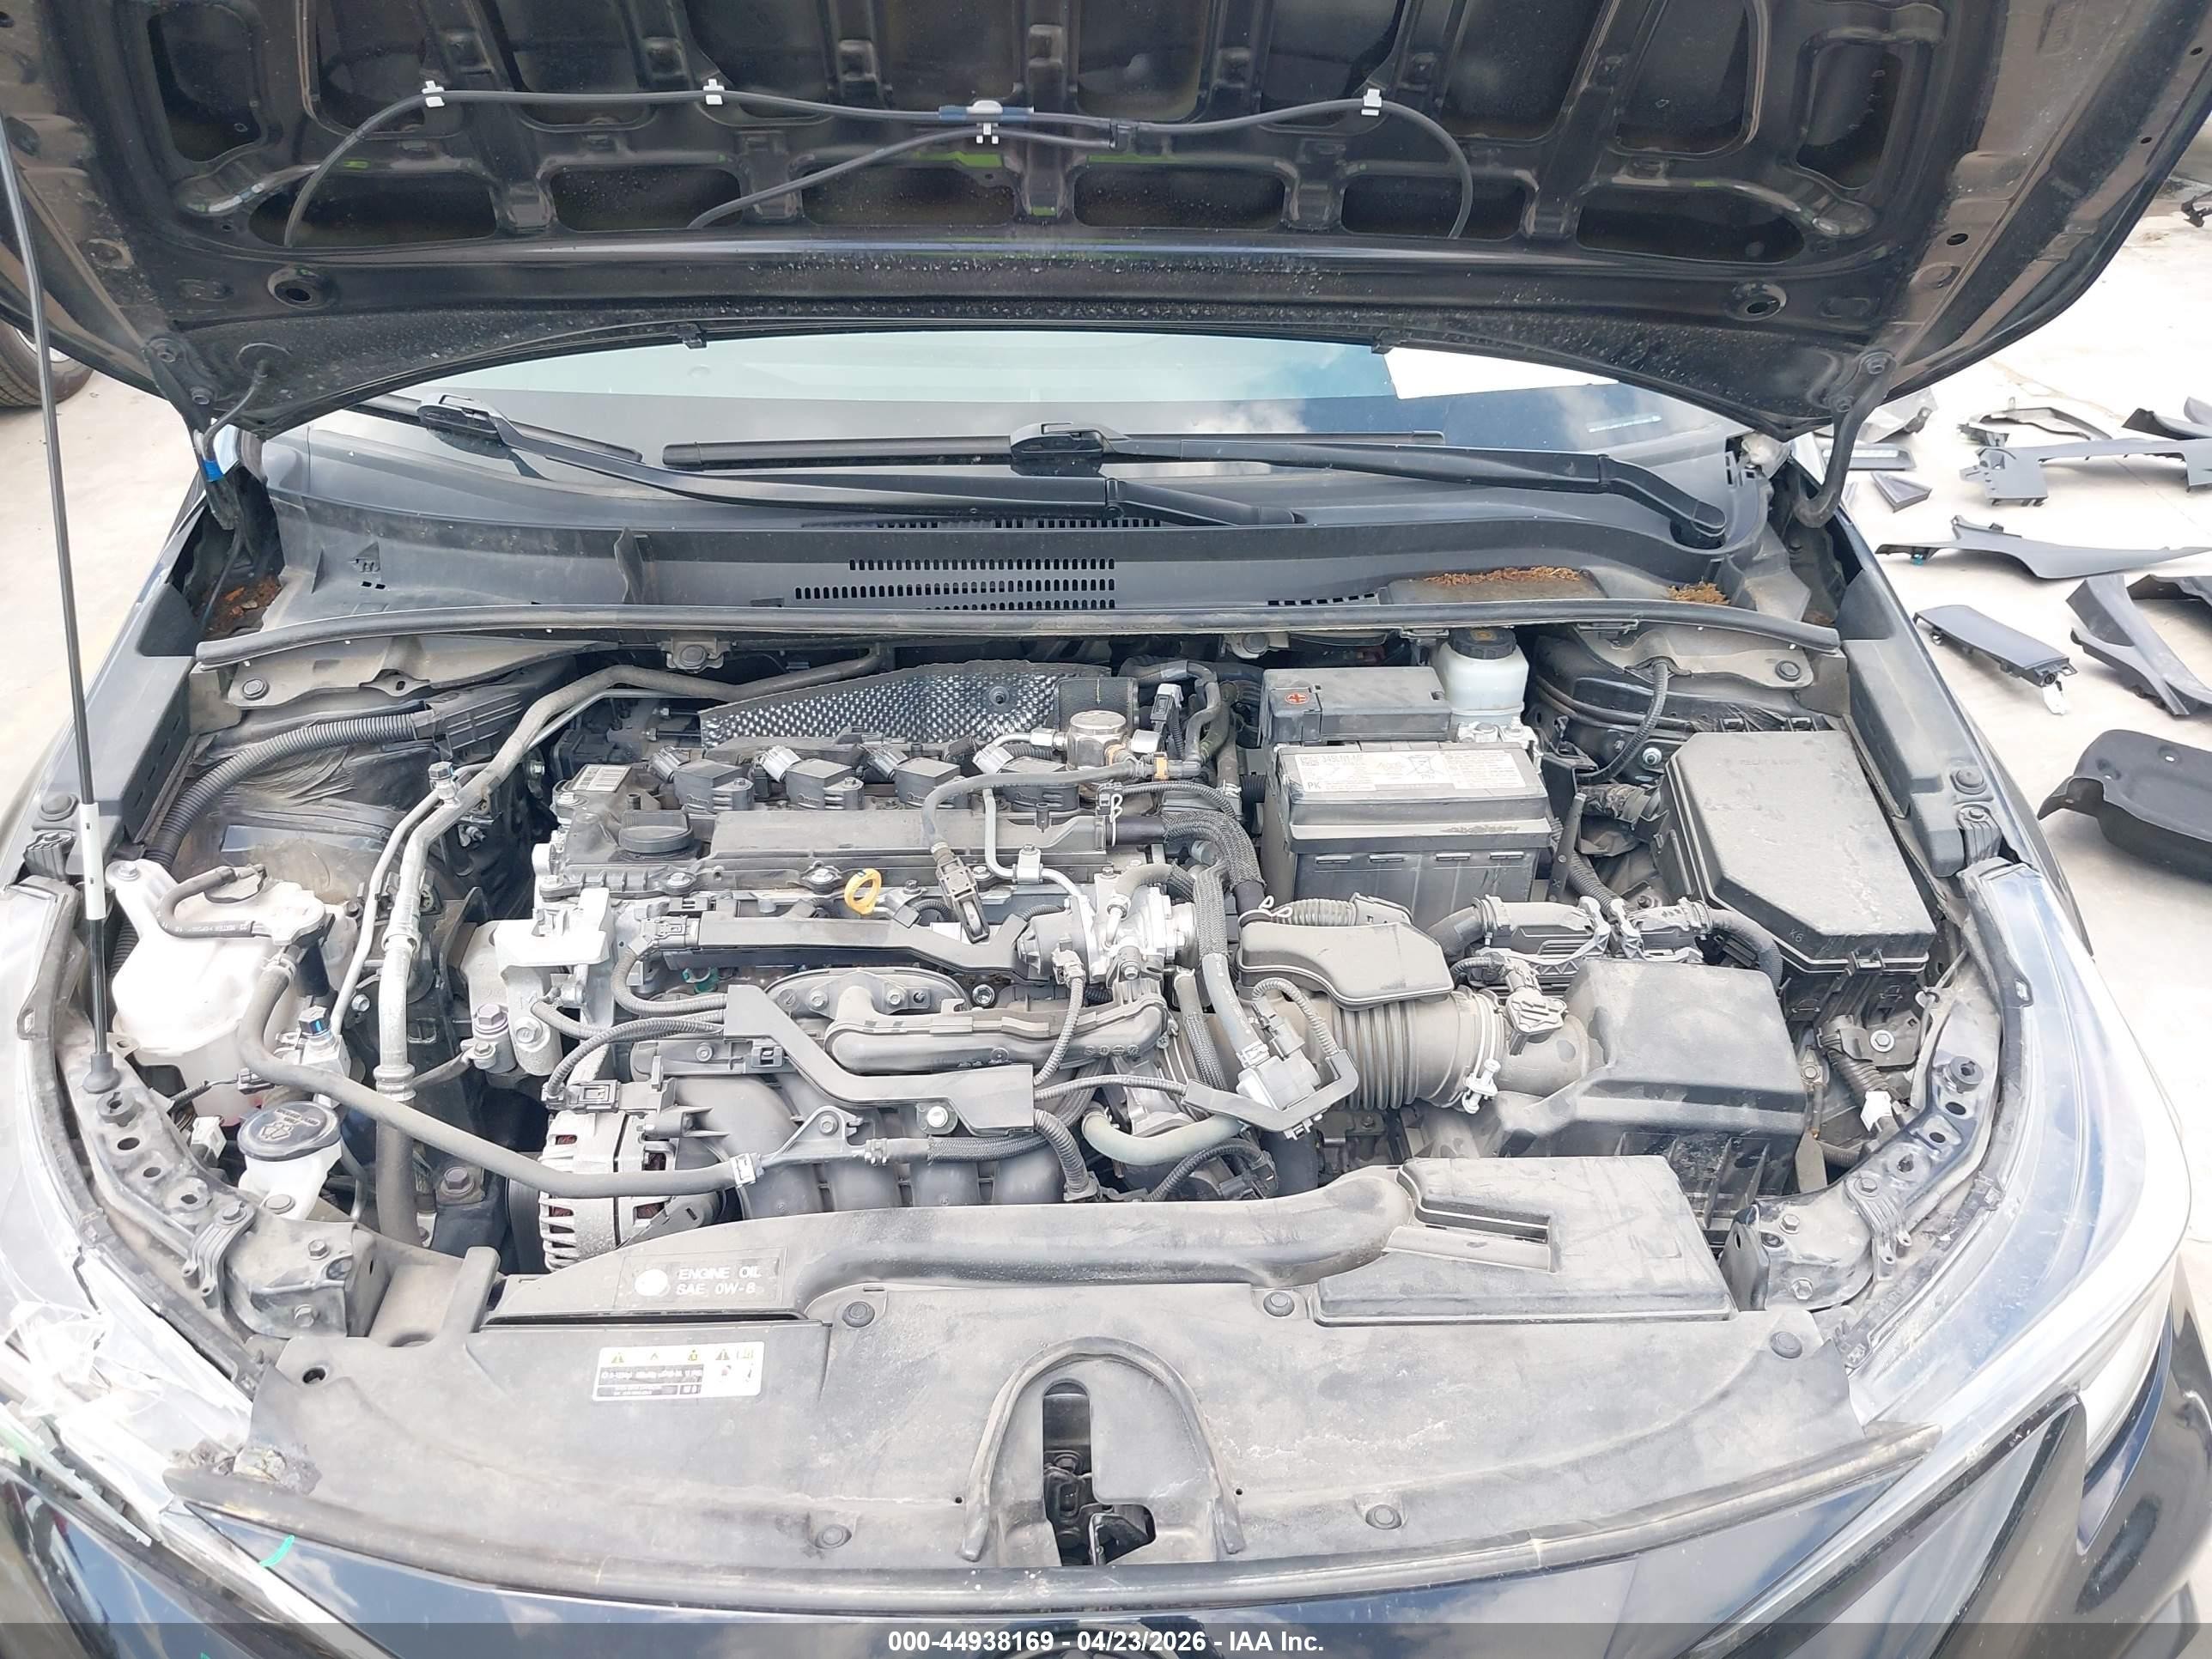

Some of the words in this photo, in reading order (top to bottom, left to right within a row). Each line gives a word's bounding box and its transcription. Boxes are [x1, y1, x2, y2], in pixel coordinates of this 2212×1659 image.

[1308, 781, 1322, 790] PK
[679, 1267, 730, 1279] ENGINE
[738, 1266, 763, 1279] OIL
[676, 1282, 707, 1295] SAE
